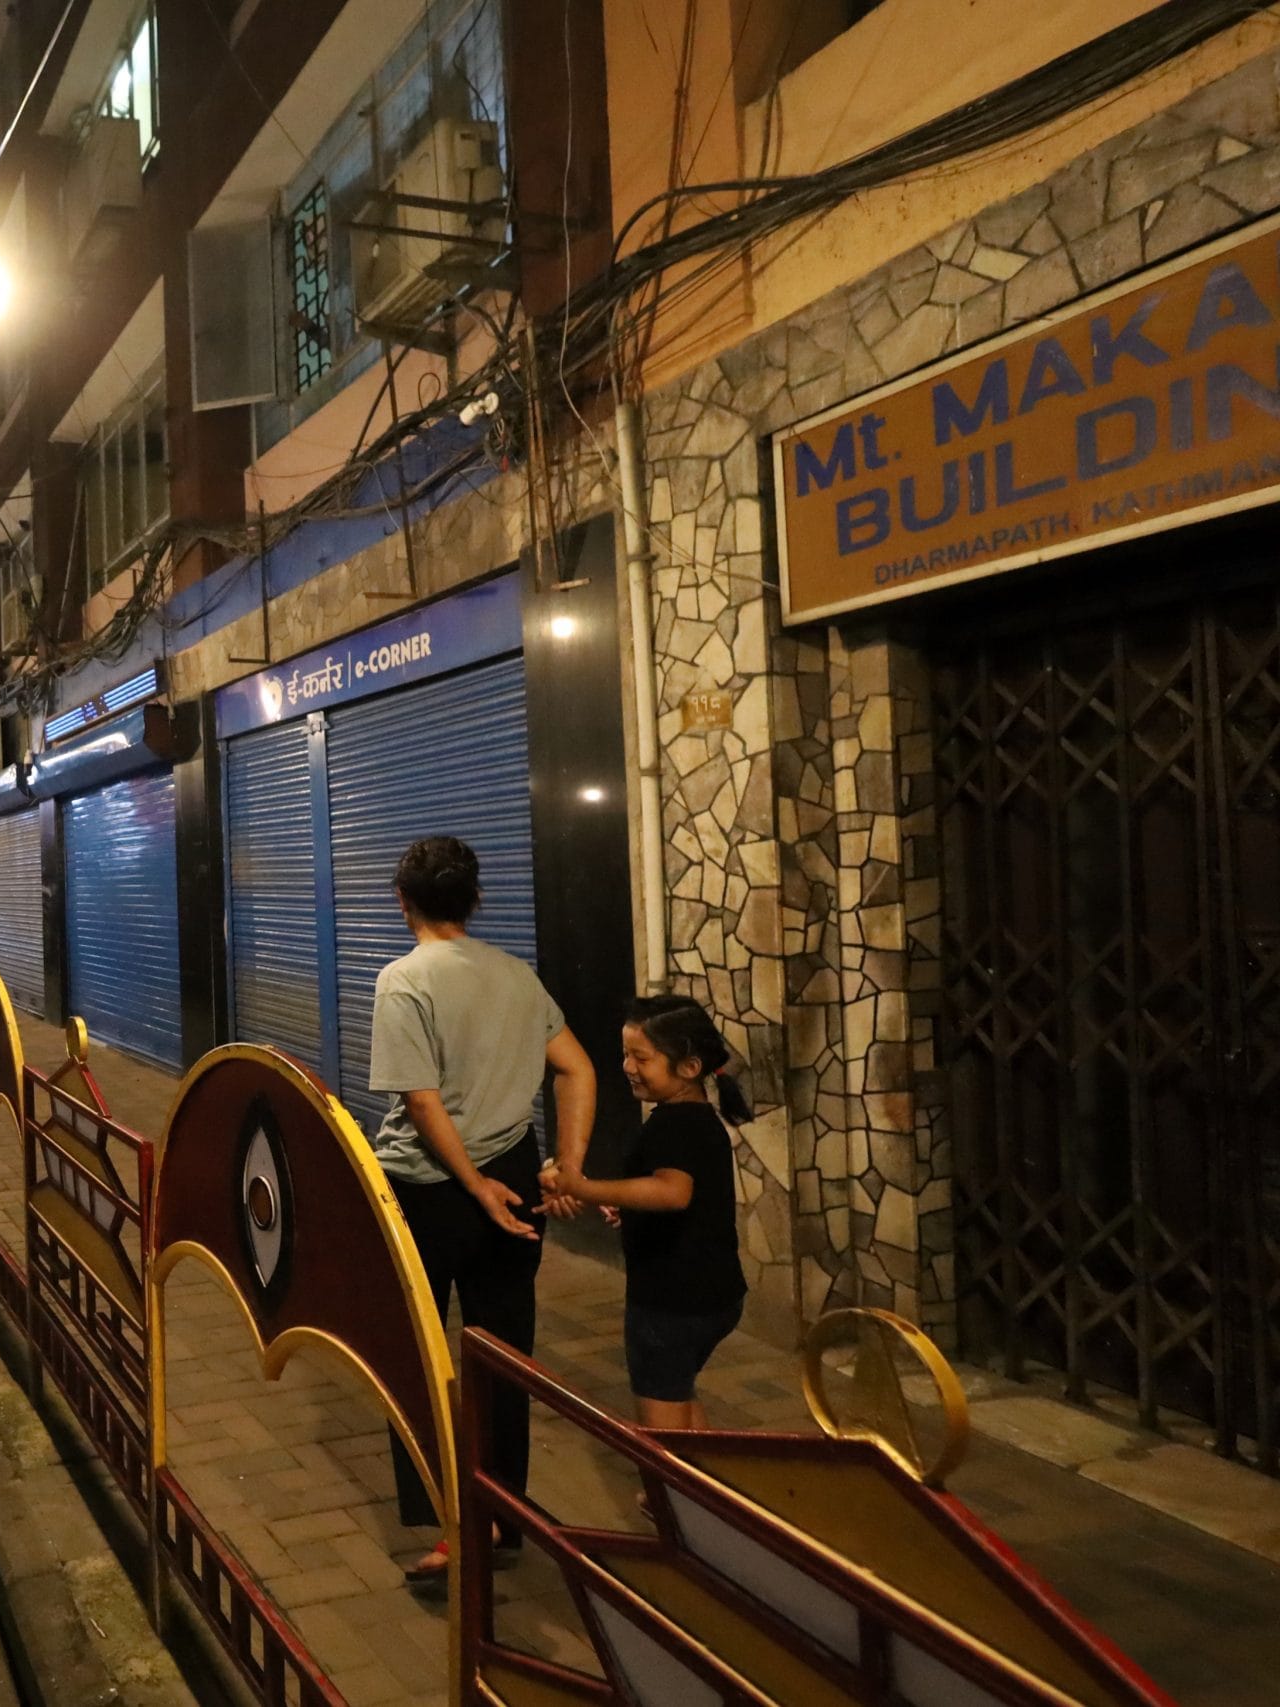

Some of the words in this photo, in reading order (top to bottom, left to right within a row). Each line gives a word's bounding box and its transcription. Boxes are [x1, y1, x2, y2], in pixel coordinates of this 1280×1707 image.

[794, 412, 902, 497] Mt.
[932, 241, 1280, 446] MAKA
[287, 655, 344, 704] ई-कर्नर
[355, 632, 431, 679] e-CORNER
